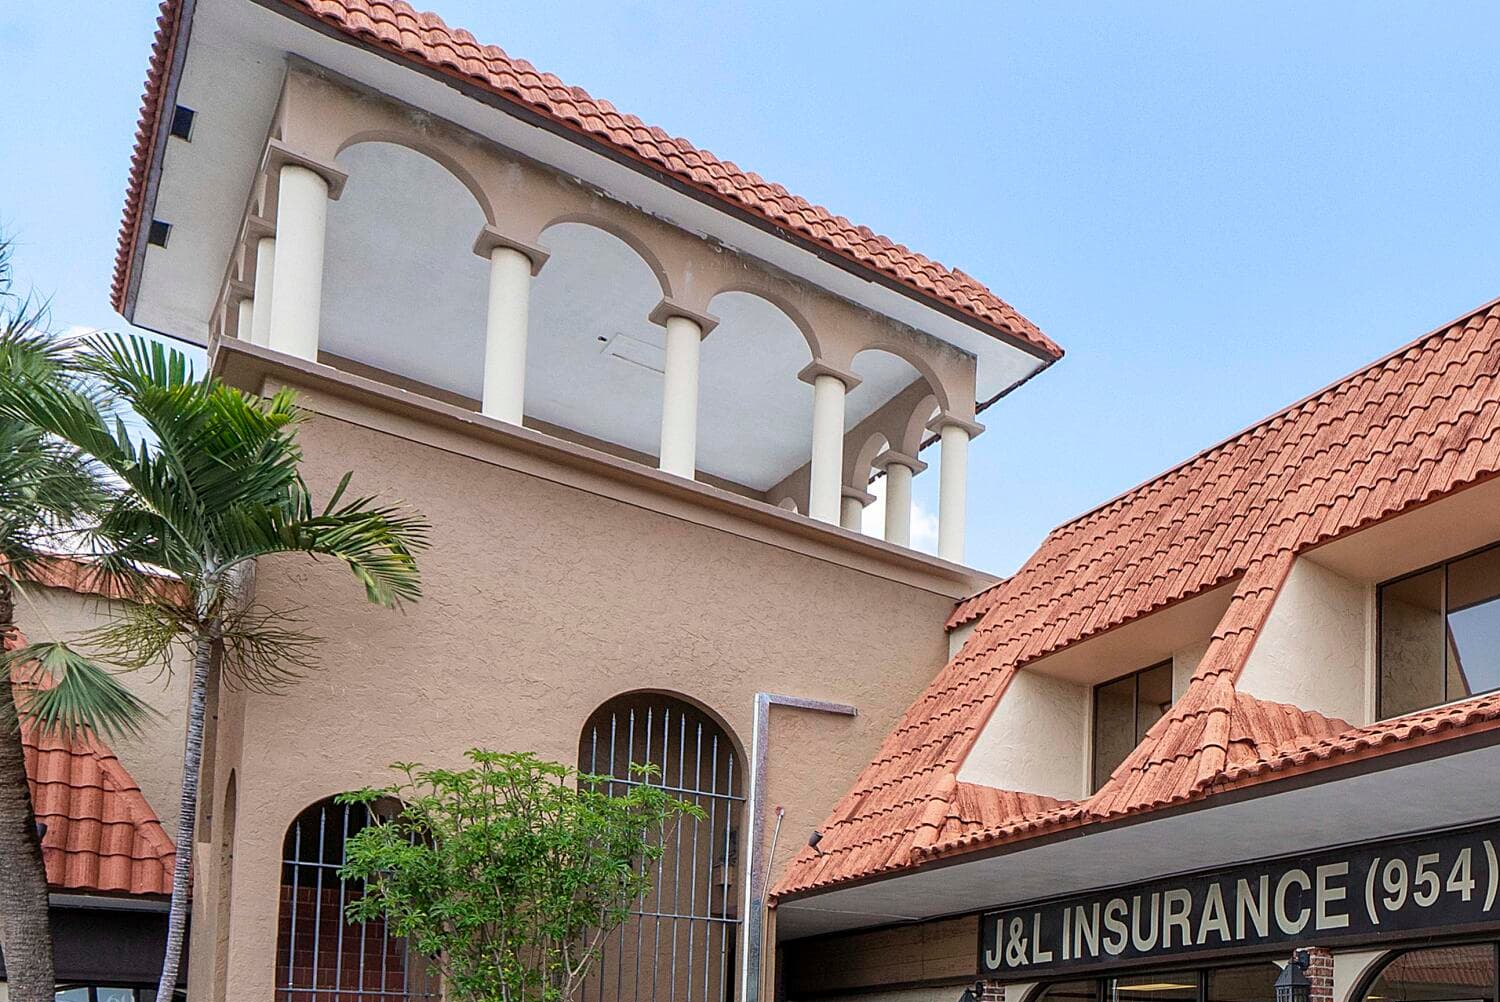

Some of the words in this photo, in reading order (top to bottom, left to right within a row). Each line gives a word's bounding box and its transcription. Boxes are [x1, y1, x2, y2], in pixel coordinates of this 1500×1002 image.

[985, 916, 1053, 971] J&L
[1062, 861, 1351, 960] INSURANCE
[1365, 840, 1499, 926] (954)
